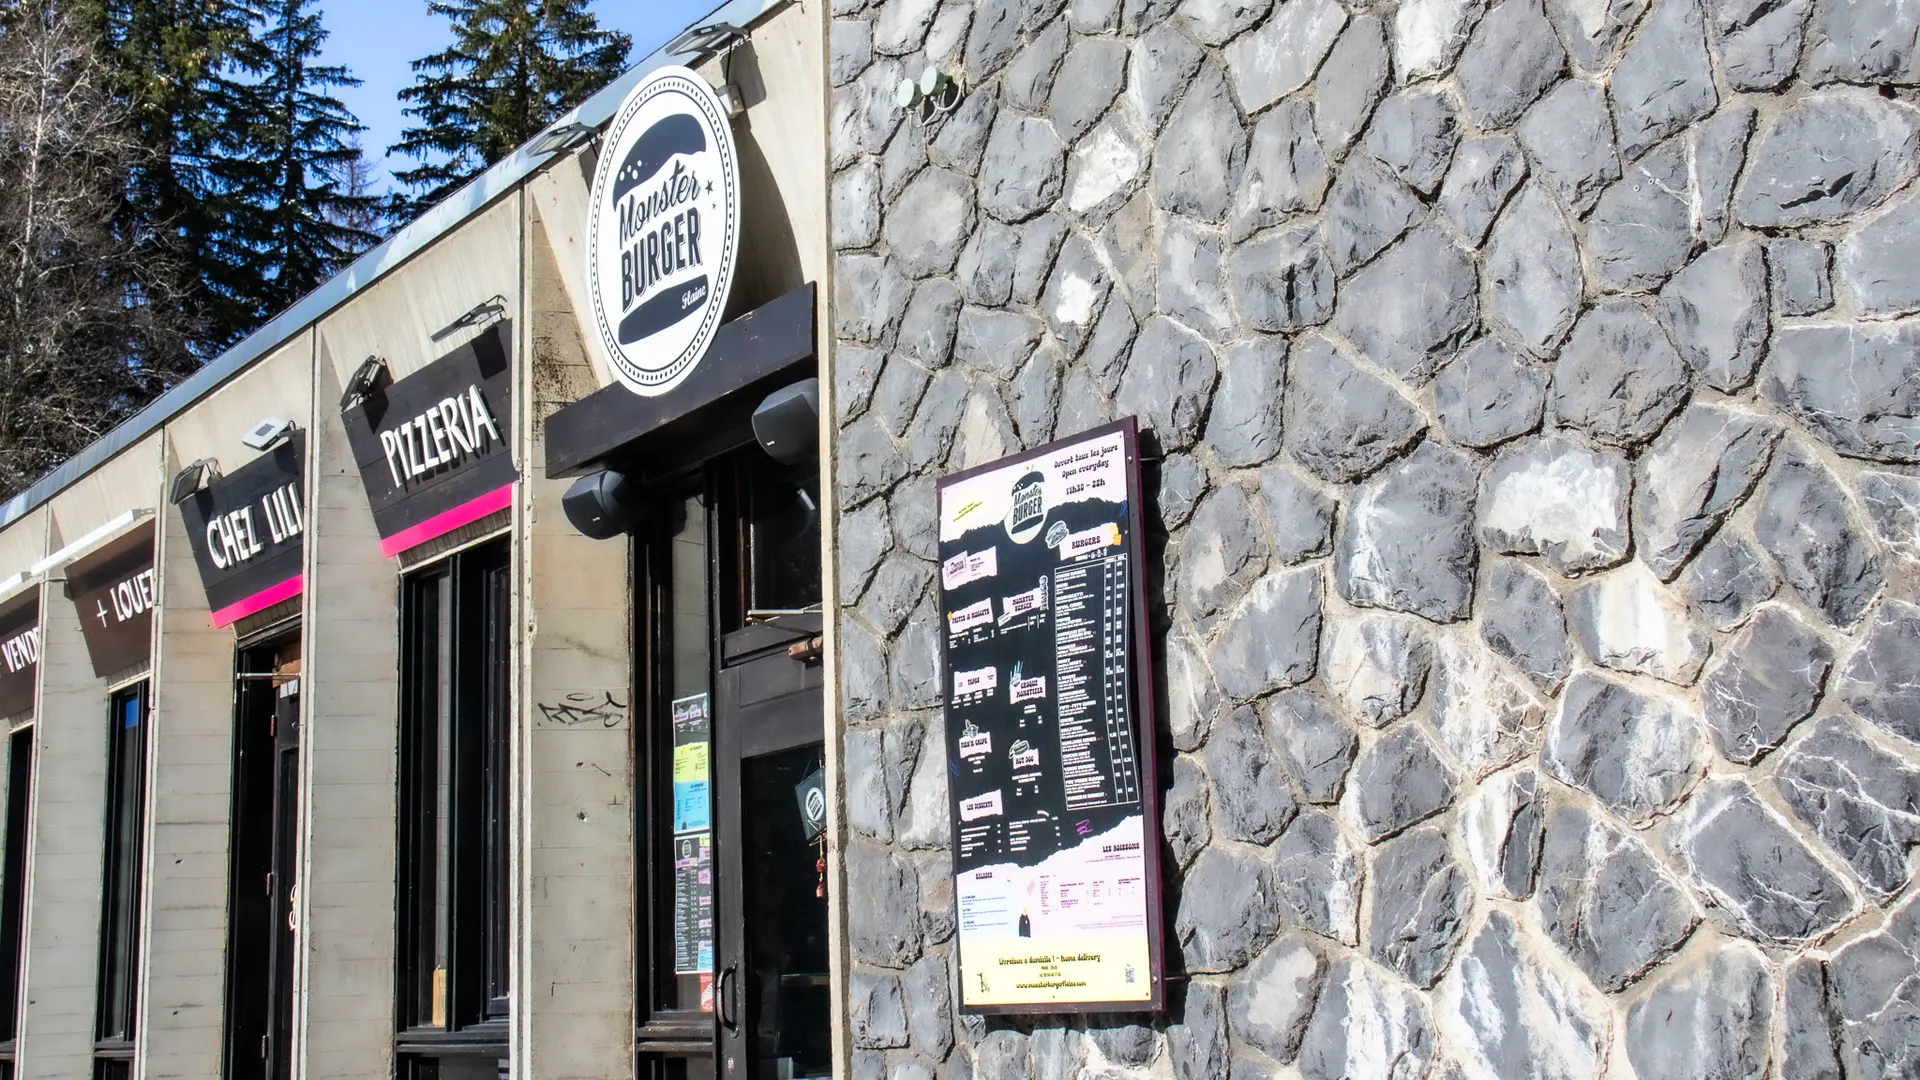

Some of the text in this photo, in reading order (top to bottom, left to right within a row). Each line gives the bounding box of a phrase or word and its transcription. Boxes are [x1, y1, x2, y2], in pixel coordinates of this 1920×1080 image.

[619, 159, 701, 250] Monster
[620, 206, 704, 313] BURGER
[681, 283, 707, 310] Flaine
[380, 384, 499, 489] PIZZERIA
[1075, 453, 1089, 462] tous
[1090, 449, 1100, 458] les
[1100, 444, 1118, 458] jours
[1062, 459, 1109, 479] Open everyday
[1013, 496, 1043, 526] BURGER
[206, 504, 264, 569] CHEZ
[1071, 535, 1101, 550] BURGERS
[1102, 845, 1112, 853] LES
[1077, 953, 1100, 962] delivery
